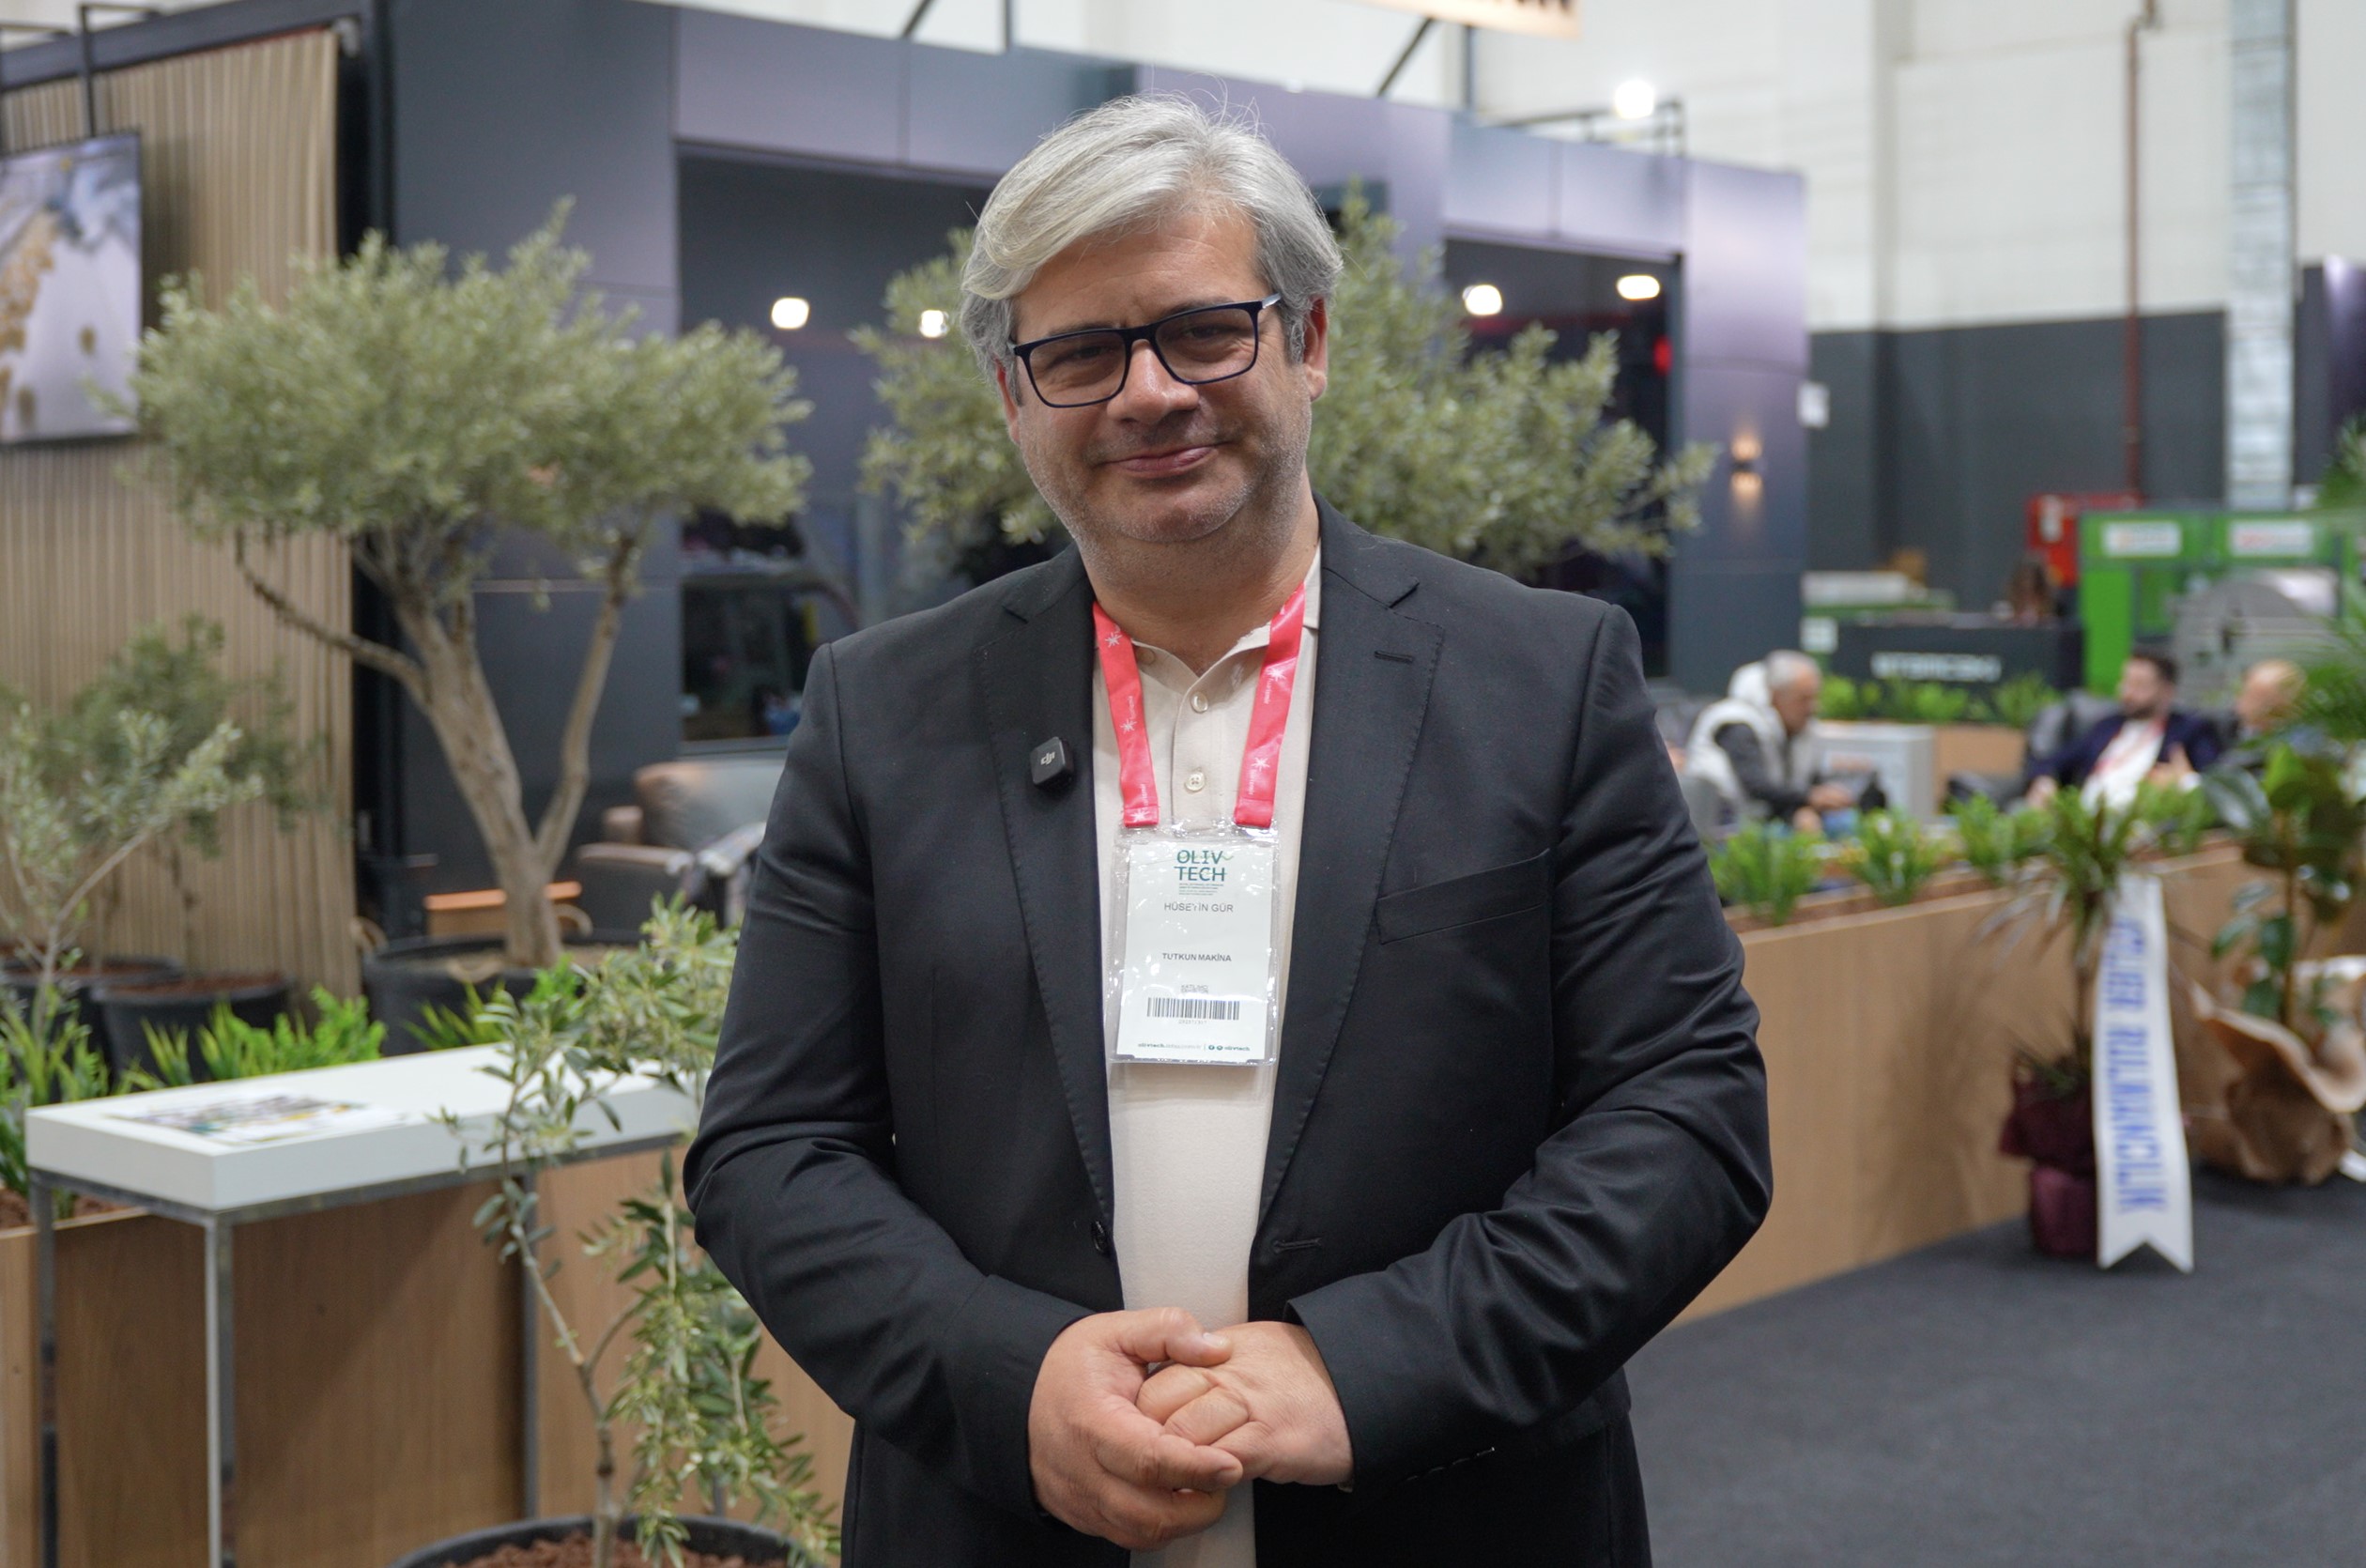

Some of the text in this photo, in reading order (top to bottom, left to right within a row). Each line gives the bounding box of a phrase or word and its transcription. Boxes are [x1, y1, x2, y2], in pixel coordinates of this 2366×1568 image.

[1176, 849, 1224, 865] OLIV
[1174, 866, 1225, 882] TECH
[1211, 903, 1234, 913] GÜR
